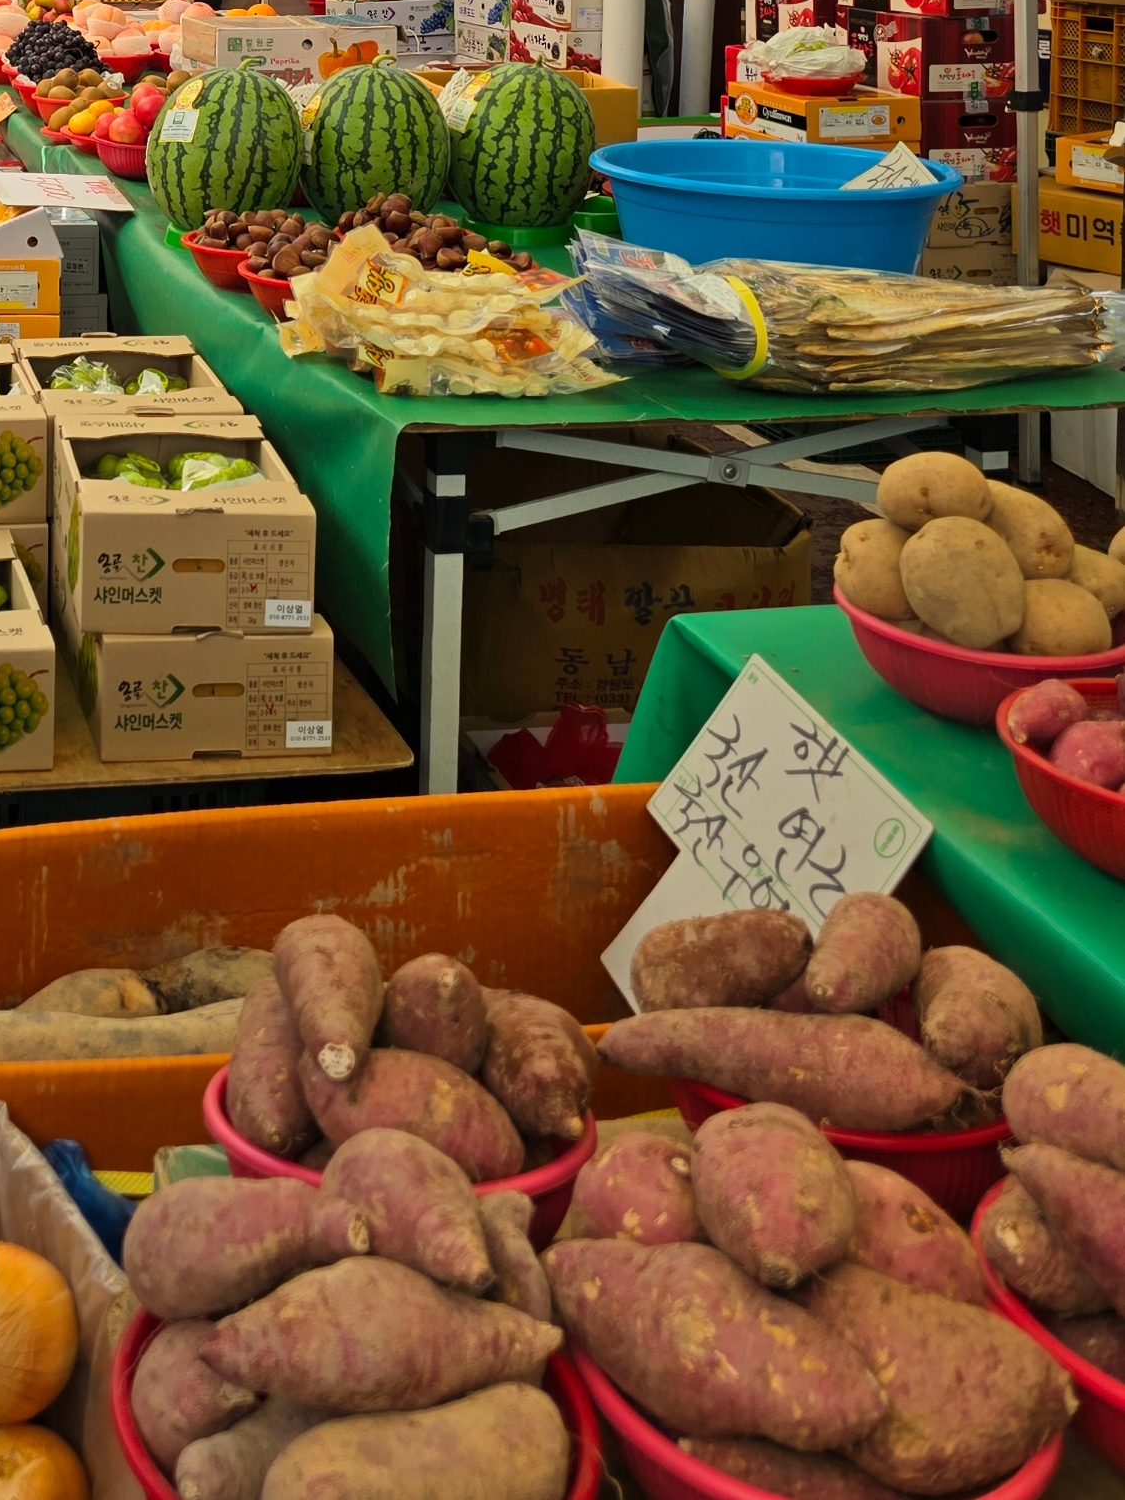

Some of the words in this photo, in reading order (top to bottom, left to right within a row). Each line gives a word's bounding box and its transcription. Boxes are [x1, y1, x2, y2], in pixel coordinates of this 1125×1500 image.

[1040, 209, 1115, 246] 햇미역
[211, 496, 287, 505] 샤인머스켓
[94, 586, 162, 604] 샤인머스켓
[277, 604, 303, 614] 이상열
[555, 678, 582, 690] 주소
[596, 678, 635, 690] 강원도
[114, 712, 183, 732] 샤인머스켓
[297, 725, 324, 734] 이상열
[703, 713, 769, 820] 국산
[782, 718, 851, 803] 햇
[671, 774, 729, 866] 국산
